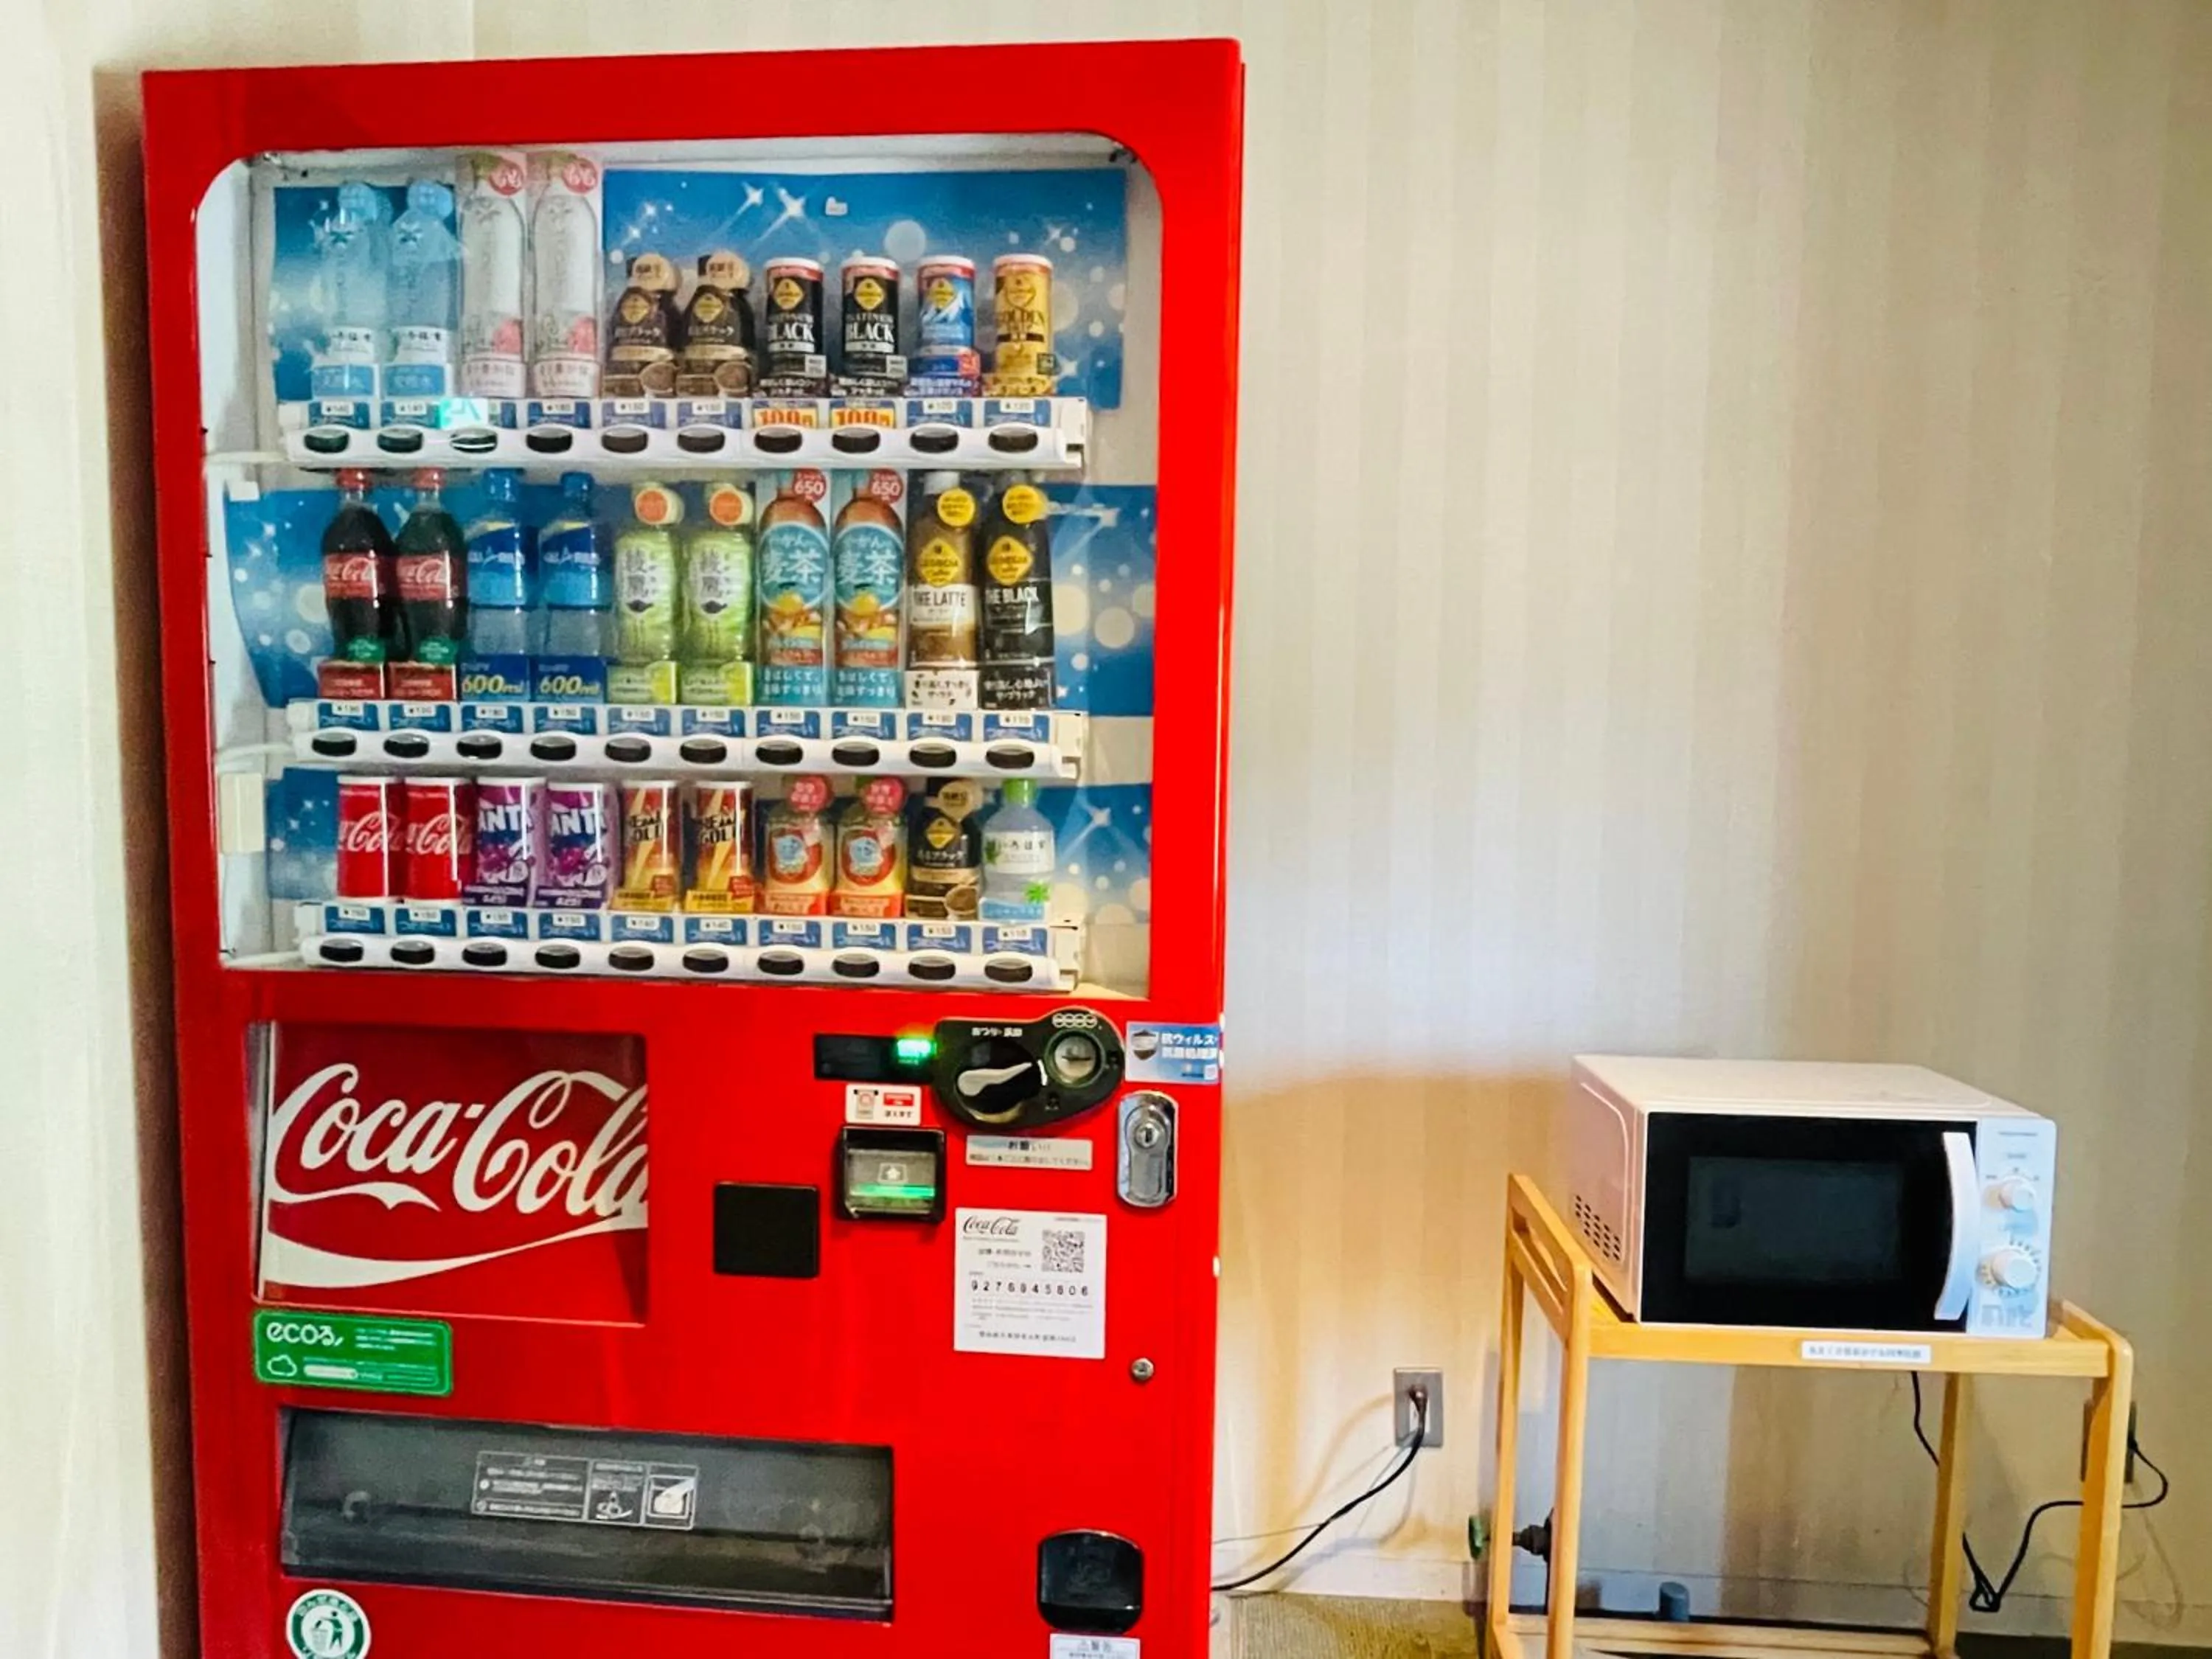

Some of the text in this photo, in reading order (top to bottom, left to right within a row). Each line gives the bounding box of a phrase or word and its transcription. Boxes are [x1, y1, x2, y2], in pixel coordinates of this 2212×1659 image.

[794, 479, 824, 495] 650
[871, 481, 901, 496] 650
[267, 1062, 648, 1217] Coca-Cola
